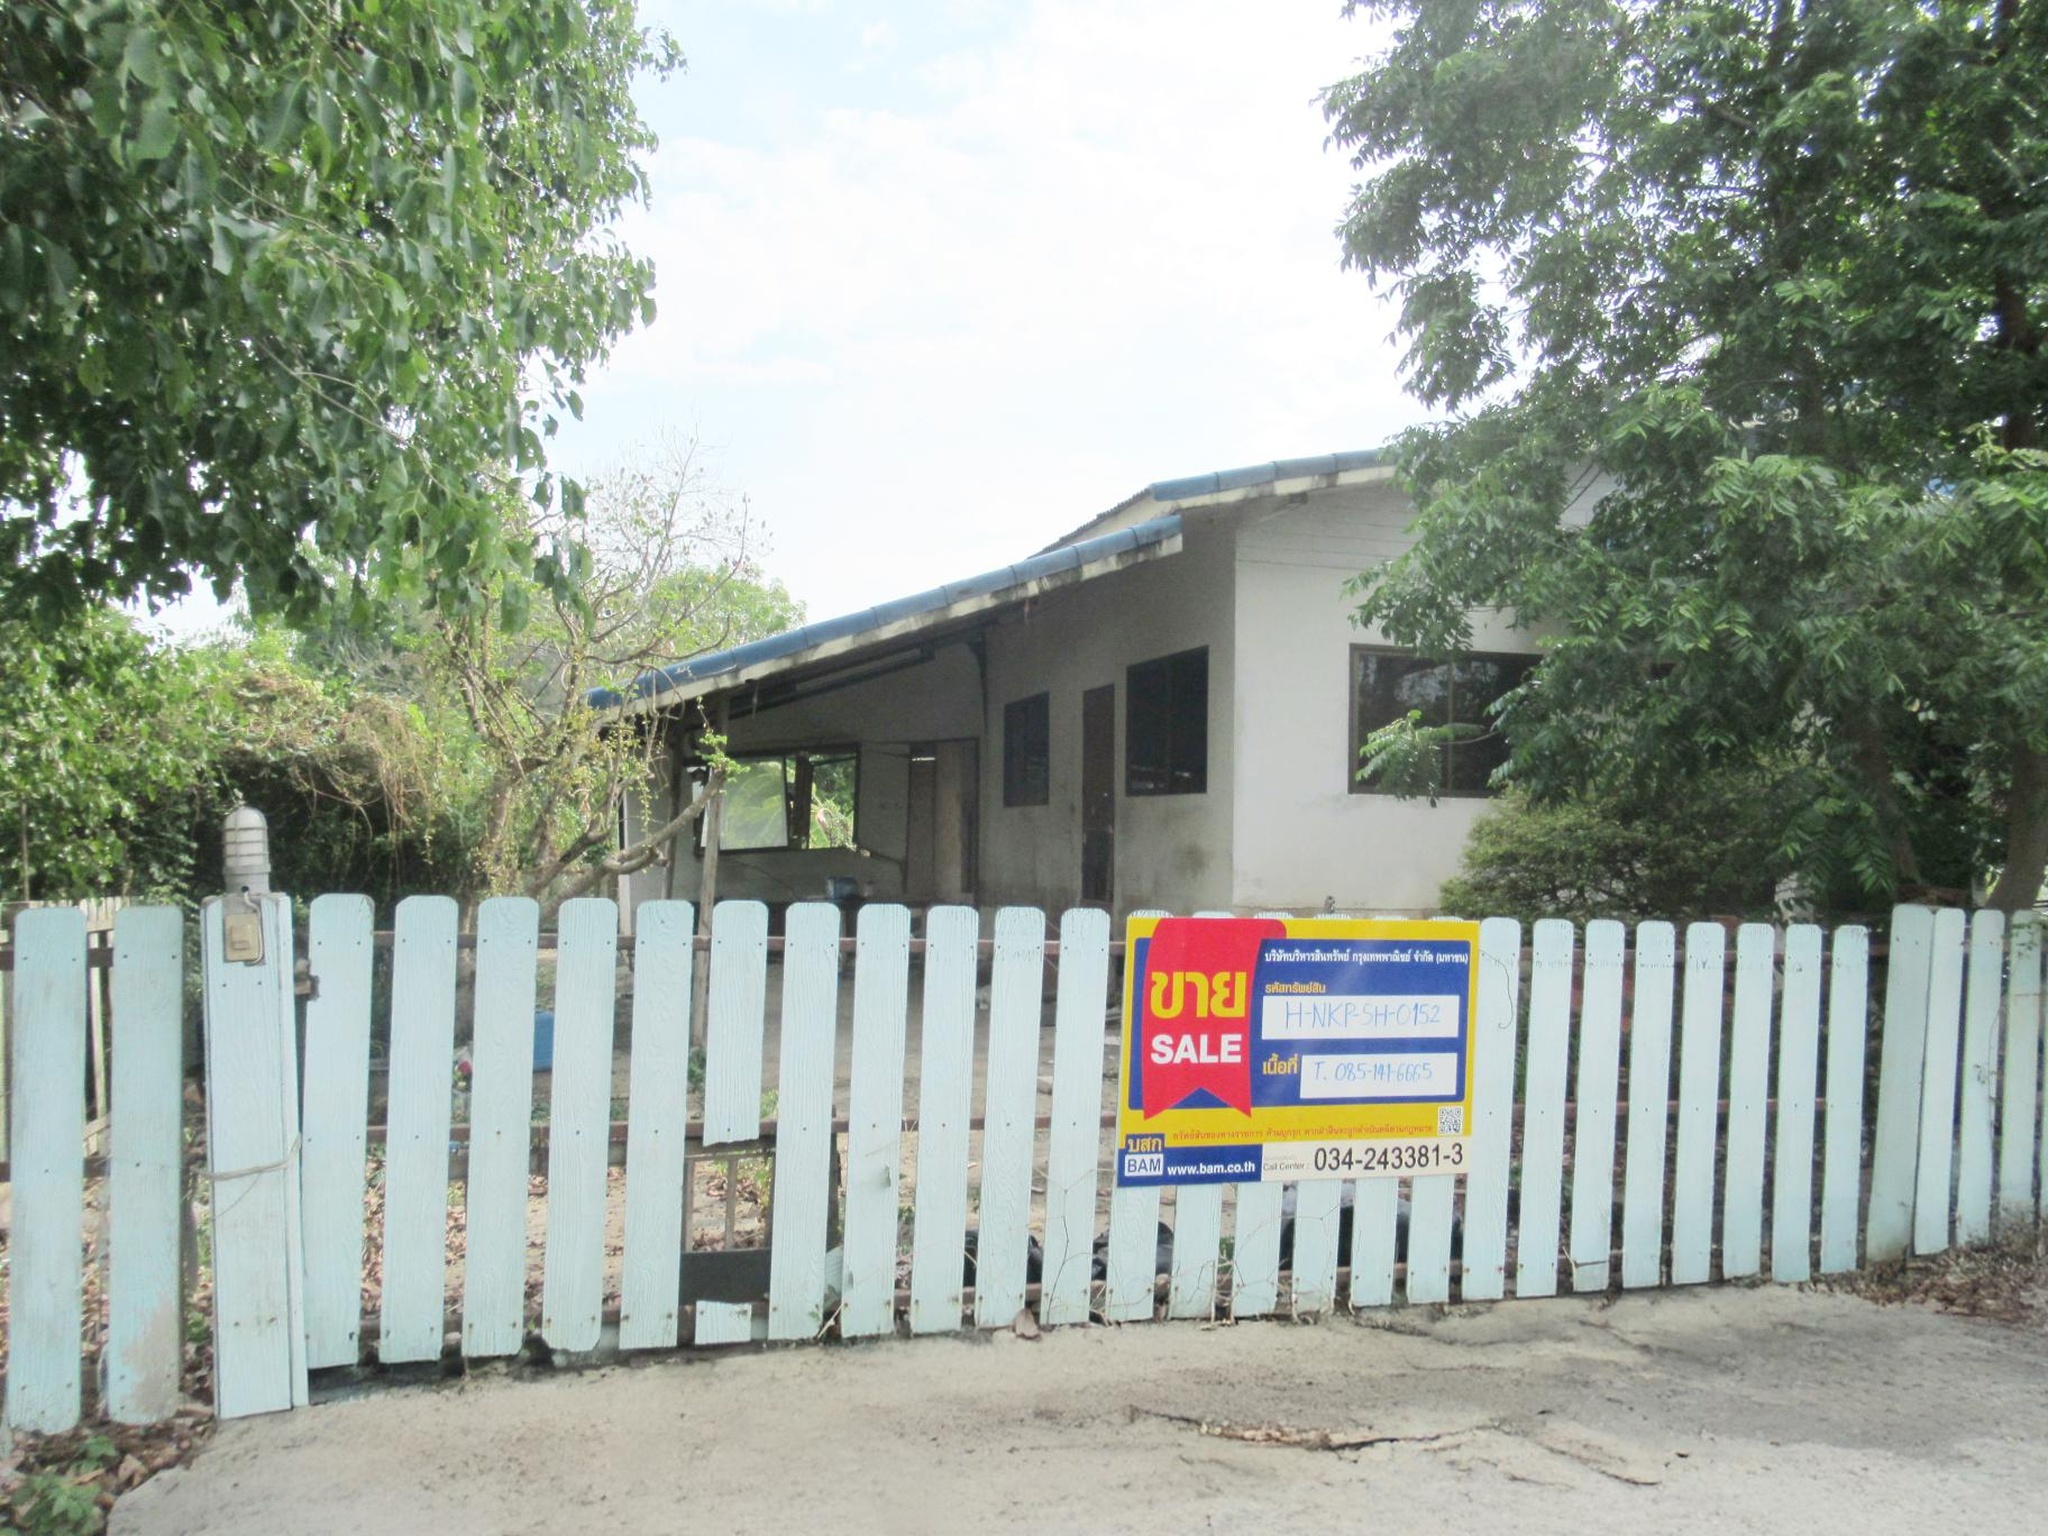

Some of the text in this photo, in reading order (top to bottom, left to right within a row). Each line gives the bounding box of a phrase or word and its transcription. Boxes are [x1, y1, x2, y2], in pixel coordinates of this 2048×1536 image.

[1265, 948, 1350, 963] บริษัทบริหารสินทรัพย์
[1413, 949, 1434, 963] จำกัด
[1436, 951, 1469, 965] (มหาชน)
[1151, 971, 1247, 1019] ขาย
[1265, 981, 1327, 994] รหัสทรัพย์สิน
[1150, 1033, 1242, 1065] SALE
[1262, 1053, 1299, 1075] เนื้อที่
[1128, 1136, 1162, 1153] บสก
[1127, 1157, 1161, 1173] BAM
[1314, 1142, 1464, 1172] 034-243381-3
[1167, 1161, 1256, 1176] www.bam.co.th
[1263, 1161, 1278, 1171] Call
